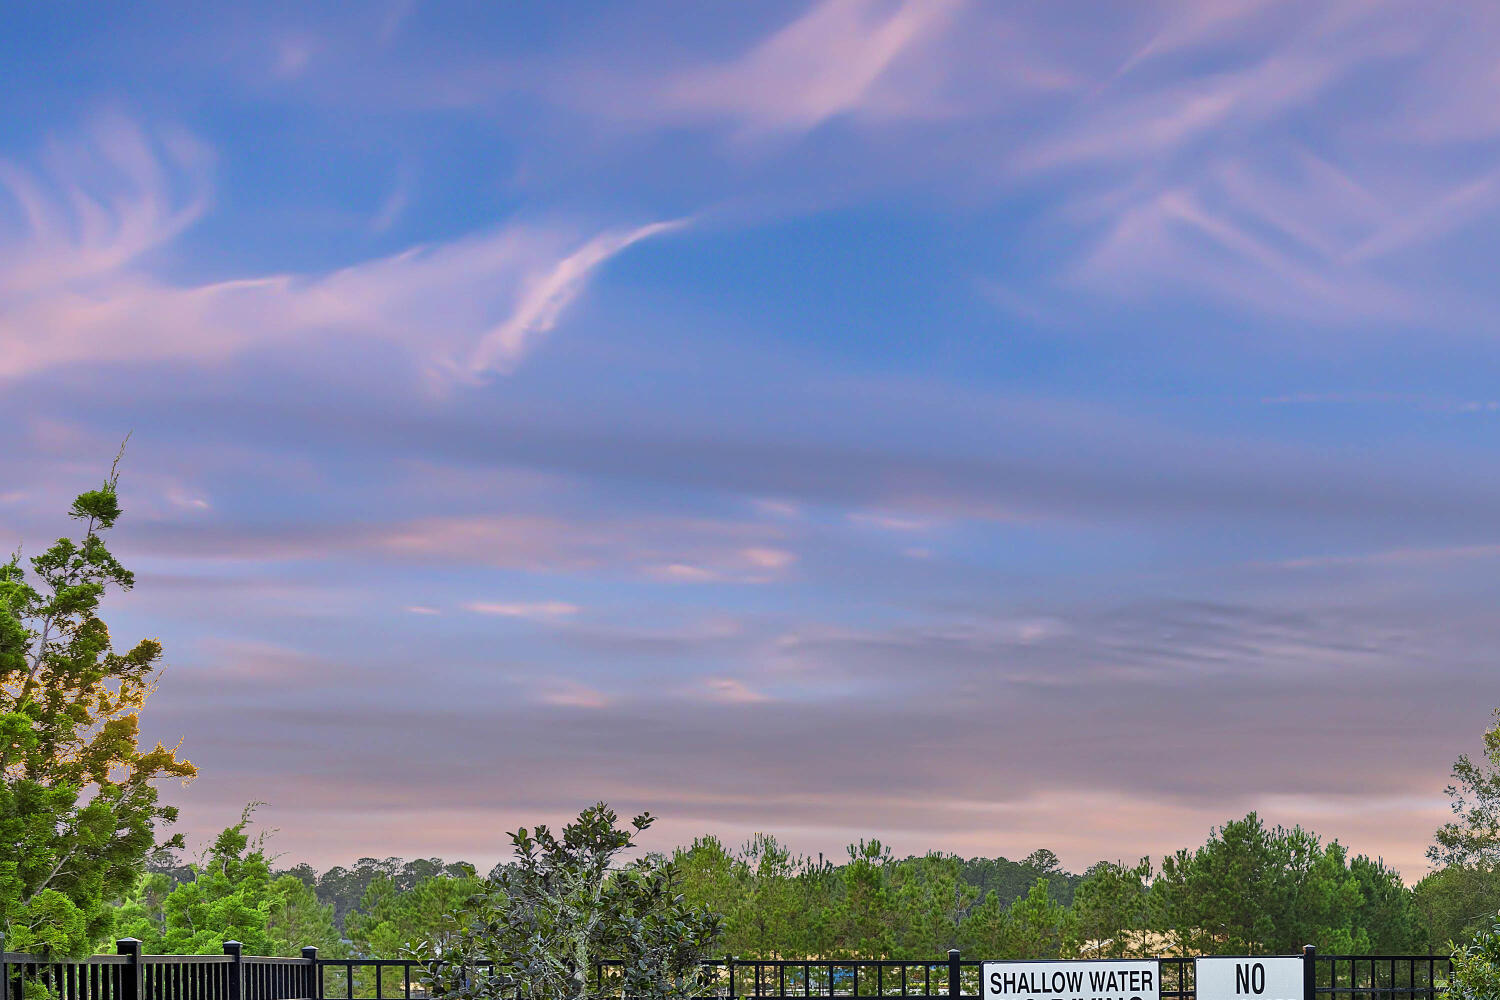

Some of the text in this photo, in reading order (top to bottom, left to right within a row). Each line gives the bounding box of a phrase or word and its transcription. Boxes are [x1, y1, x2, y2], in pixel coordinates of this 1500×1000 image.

[990, 970, 1153, 994] SHALLOW WATER
[1236, 962, 1265, 995] NO
